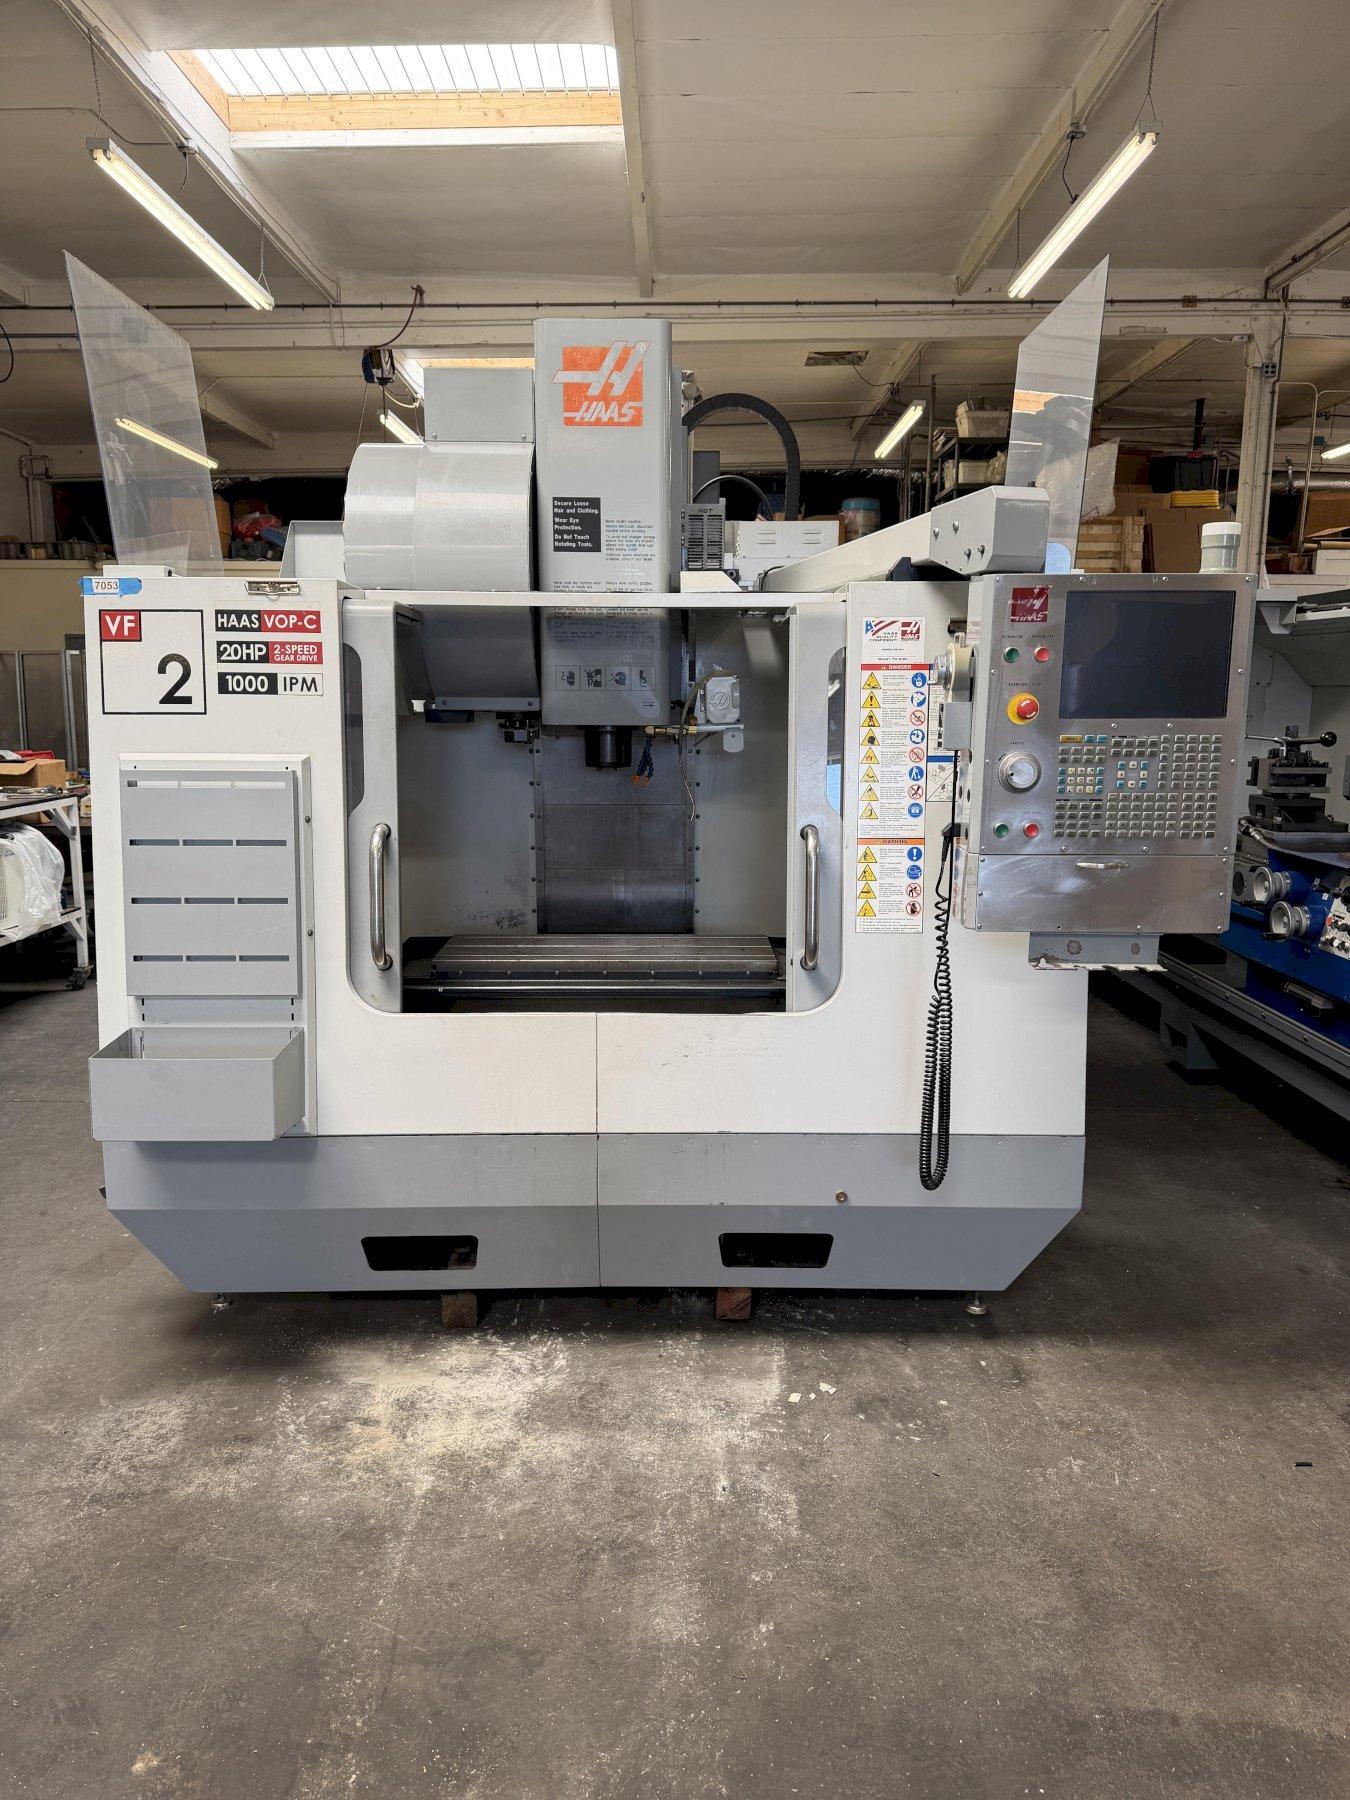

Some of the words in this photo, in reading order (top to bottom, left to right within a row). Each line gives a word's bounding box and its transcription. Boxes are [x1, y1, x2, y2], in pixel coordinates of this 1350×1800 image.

[562, 401, 643, 423] HAAS
[94, 581, 119, 590] 7053
[105, 615, 136, 637] VF
[217, 613, 259, 628] HAAS
[263, 614, 317, 629] VOP-C
[219, 643, 267, 661] 20HP
[274, 644, 318, 655] 2-SPEED
[274, 654, 295, 662] GEAR
[296, 654, 318, 662] DRIVE
[157, 653, 193, 705] 2
[225, 675, 269, 692] 1000
[283, 676, 318, 692] IPM
